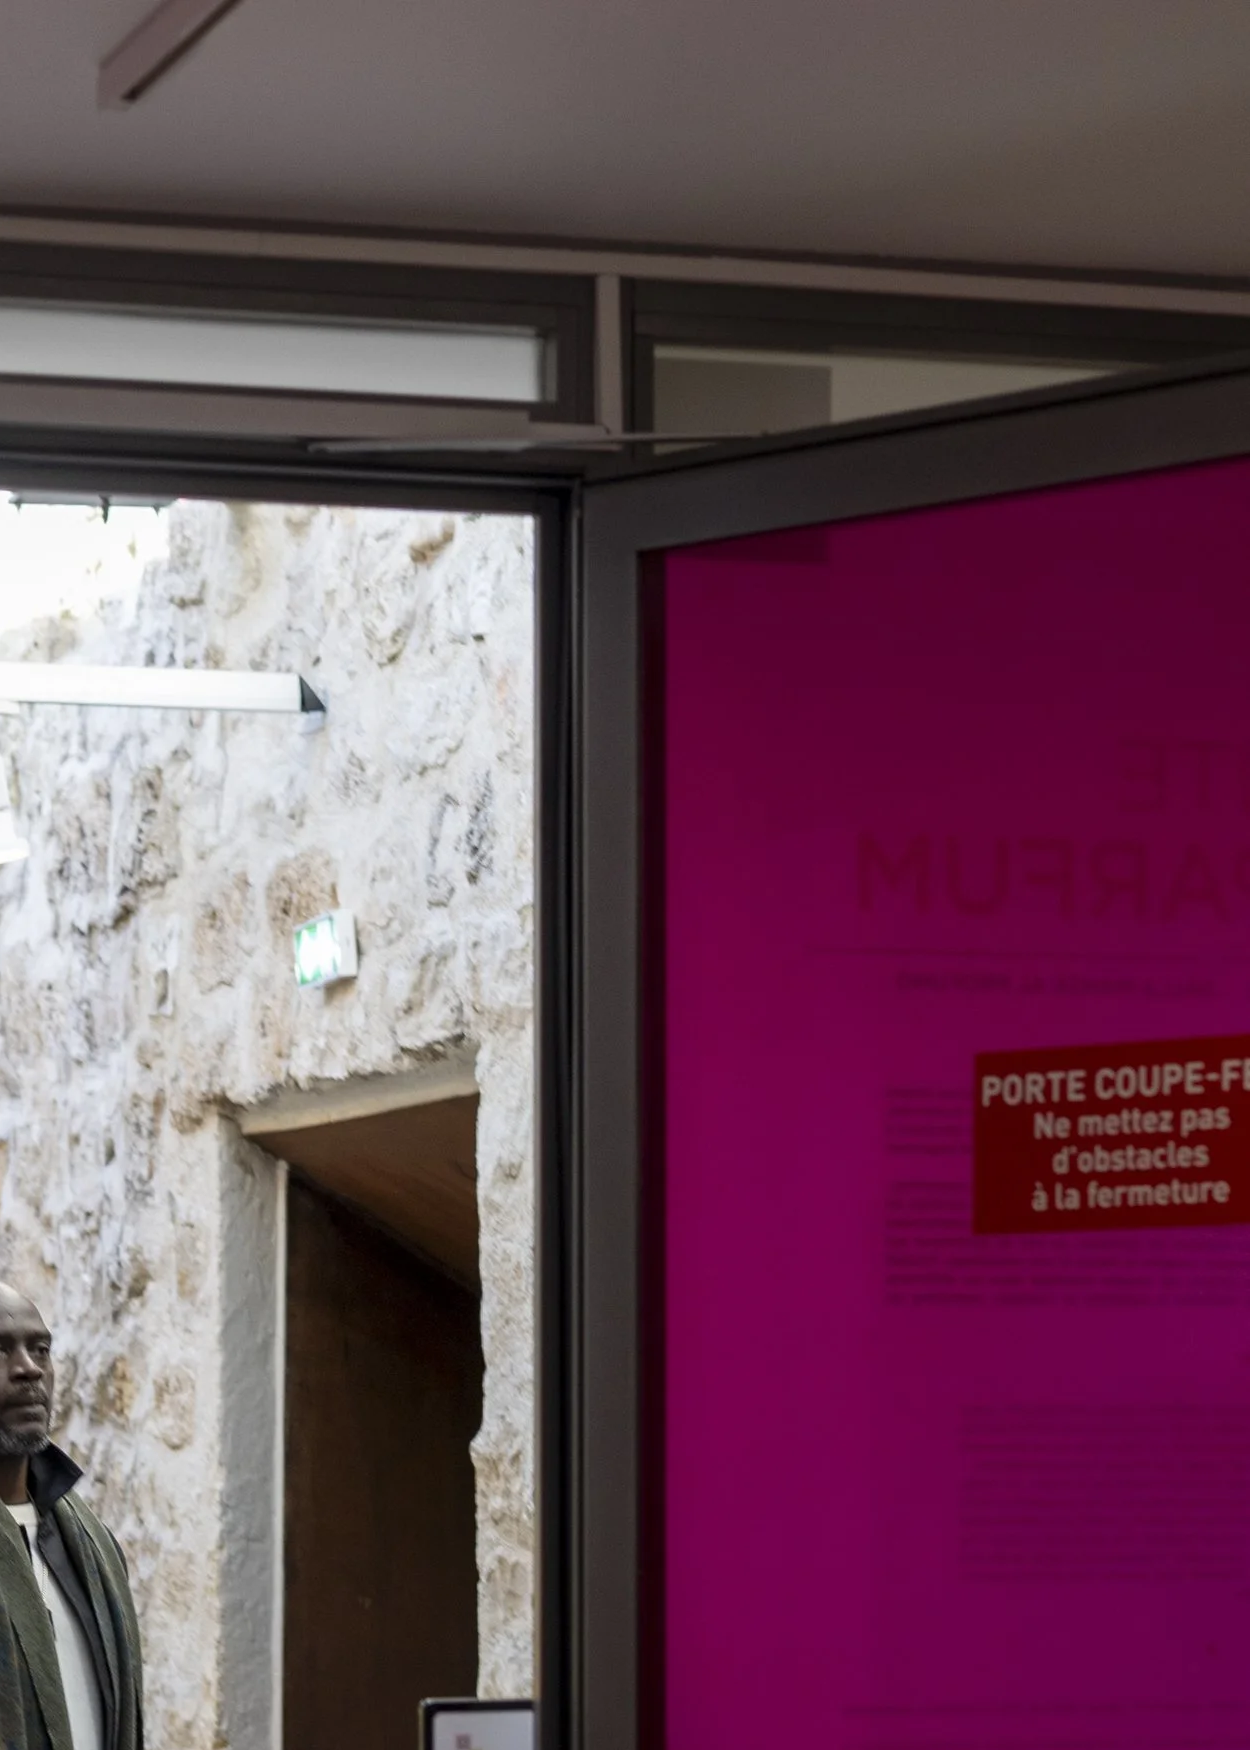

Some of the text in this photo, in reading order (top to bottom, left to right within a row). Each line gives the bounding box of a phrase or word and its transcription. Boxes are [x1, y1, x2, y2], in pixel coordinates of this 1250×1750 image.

[982, 1070, 1087, 1107] PORTE
[1034, 1106, 1232, 1139] Ne mettez pas
[1052, 1141, 1210, 1175] d'obstacles
[1031, 1178, 1231, 1212] à la fermeture
